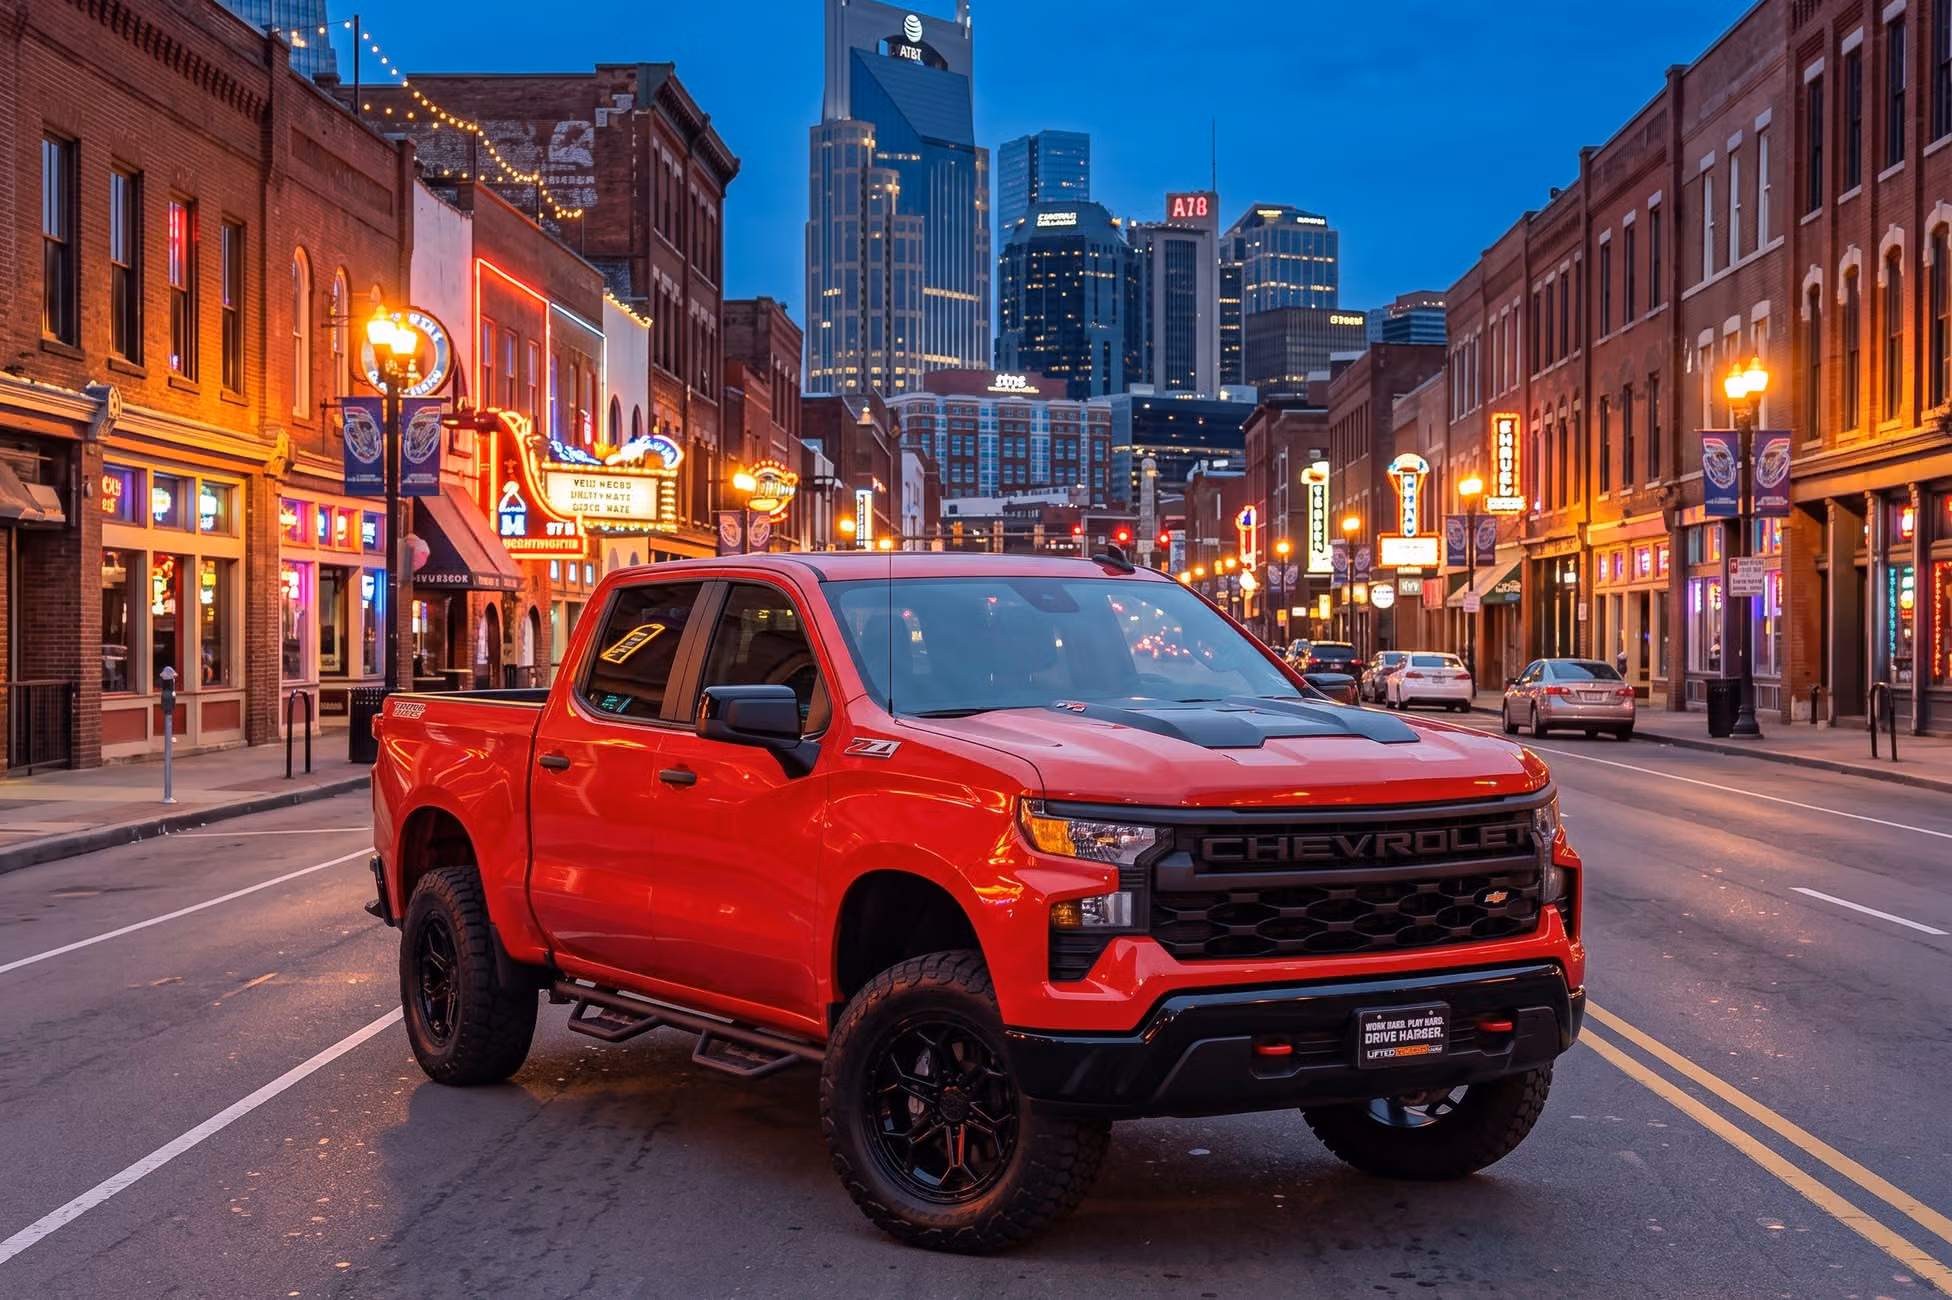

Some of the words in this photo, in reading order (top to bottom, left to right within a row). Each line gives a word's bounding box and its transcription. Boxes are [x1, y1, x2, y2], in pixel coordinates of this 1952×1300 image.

[1203, 822, 1534, 862] CHEVROLET
[1365, 1022, 1386, 1032] WORK
[1407, 1018, 1424, 1028] PLAY
[1365, 1031, 1397, 1045] DRIVE
